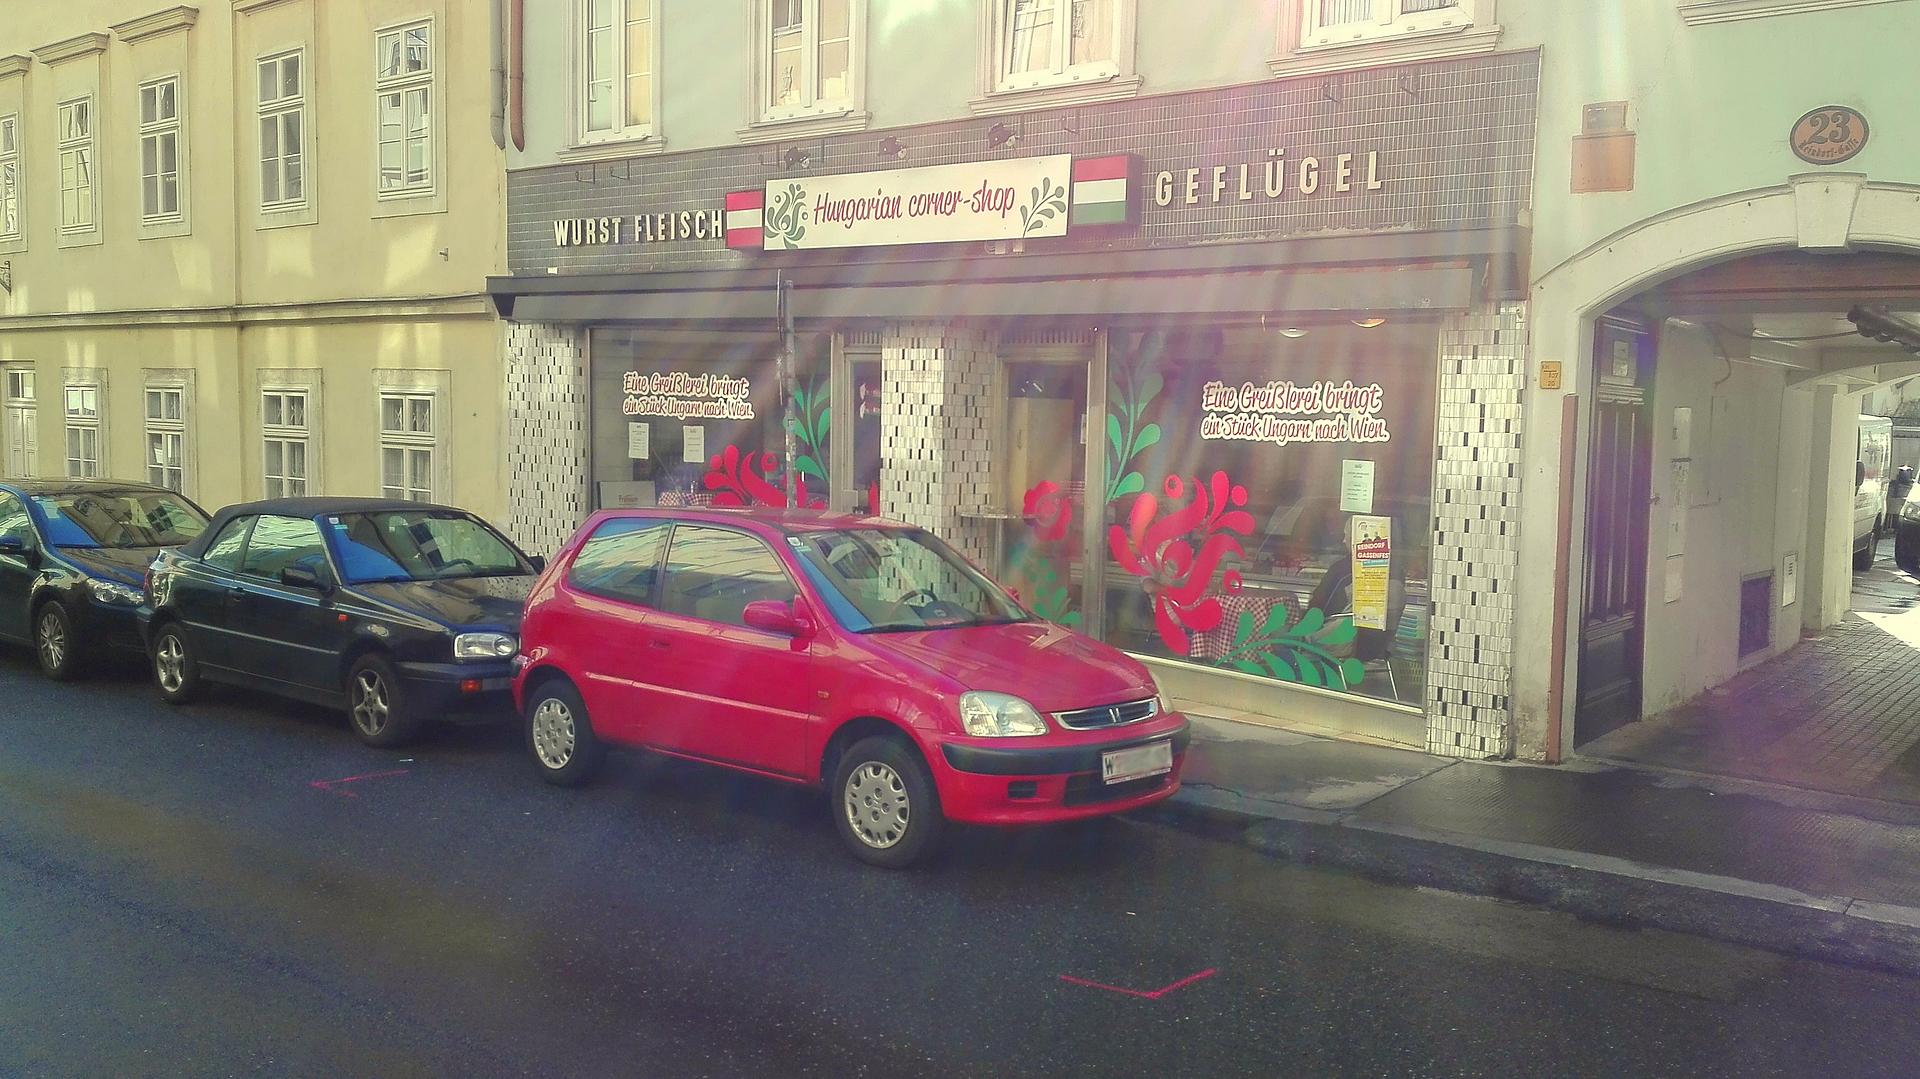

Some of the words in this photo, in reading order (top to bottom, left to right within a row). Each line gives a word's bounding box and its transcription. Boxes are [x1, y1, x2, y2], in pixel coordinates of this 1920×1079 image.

[1804, 111, 1851, 146] 23
[1155, 148, 1382, 207] GEFLÜGEL
[813, 188, 903, 230] Hungarian
[908, 178, 1016, 219] corner-shop
[553, 217, 622, 246] WURST
[634, 209, 723, 242] FLEISCH
[624, 372, 648, 393] Eine
[650, 372, 708, 396] Greißlerei
[710, 374, 749, 399] bringt
[1203, 381, 1236, 410] Eine
[1240, 380, 1321, 412] Greißlerei
[1325, 380, 1382, 415] bringt
[623, 396, 638, 415] ein
[639, 396, 667, 415] Stück
[667, 397, 701, 419] Ungarn
[703, 399, 726, 417] nach
[727, 399, 754, 418] Wien.
[1202, 414, 1222, 436] ein
[1223, 414, 1261, 438] Stück
[1262, 415, 1312, 444] Ungarn
[1315, 414, 1347, 439] nach
[1349, 415, 1388, 440] Wien.
